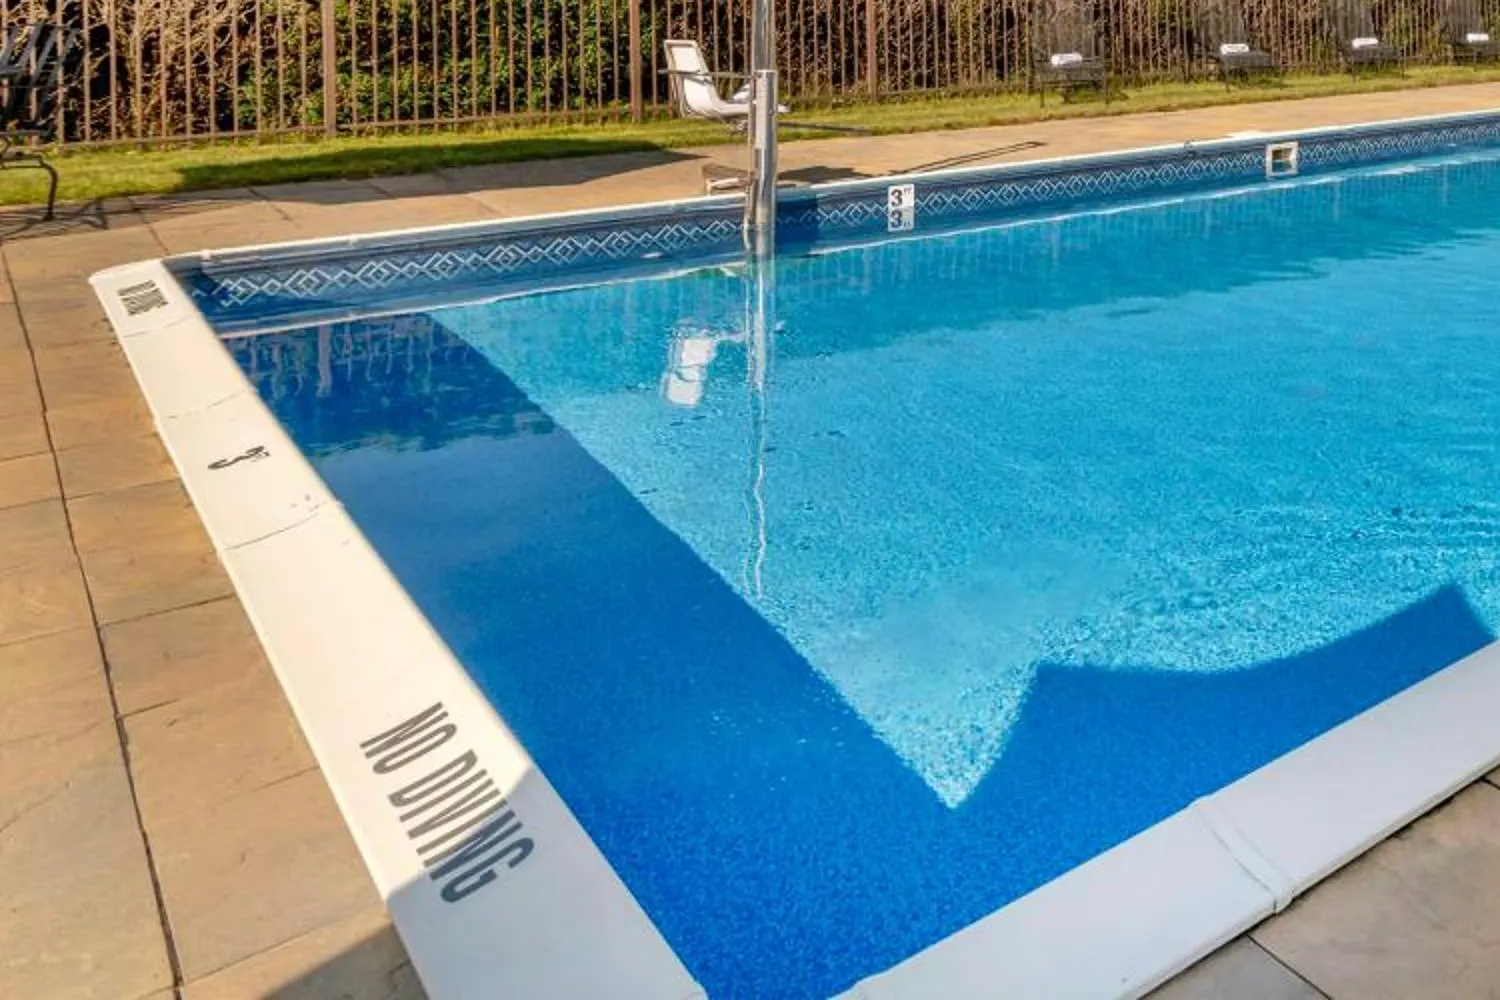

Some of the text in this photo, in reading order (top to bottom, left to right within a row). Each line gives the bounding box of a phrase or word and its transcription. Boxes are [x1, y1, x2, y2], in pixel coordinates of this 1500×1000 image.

[891, 189, 903, 207] 3
[891, 210, 903, 228] 3
[360, 701, 535, 903] NO DIVING
